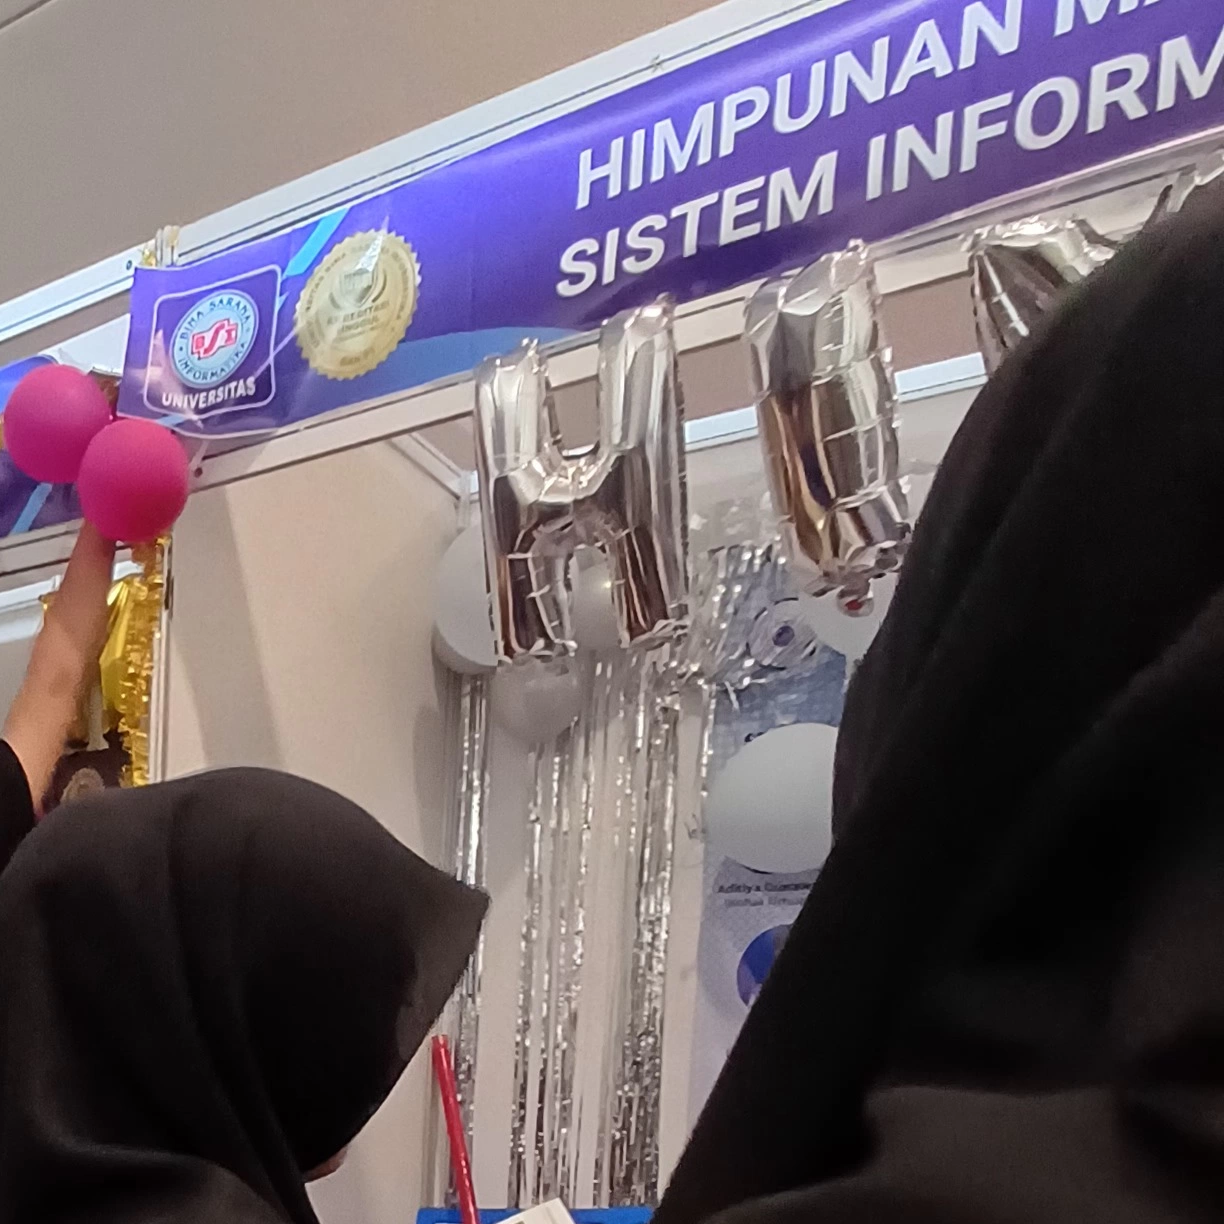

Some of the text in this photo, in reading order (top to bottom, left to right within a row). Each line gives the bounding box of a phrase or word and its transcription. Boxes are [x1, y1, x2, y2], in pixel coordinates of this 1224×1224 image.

[575, 0, 1024, 211] HIMPUNAN
[555, 150, 838, 298] SISTEM
[161, 376, 257, 410] UNIVERSITAS
